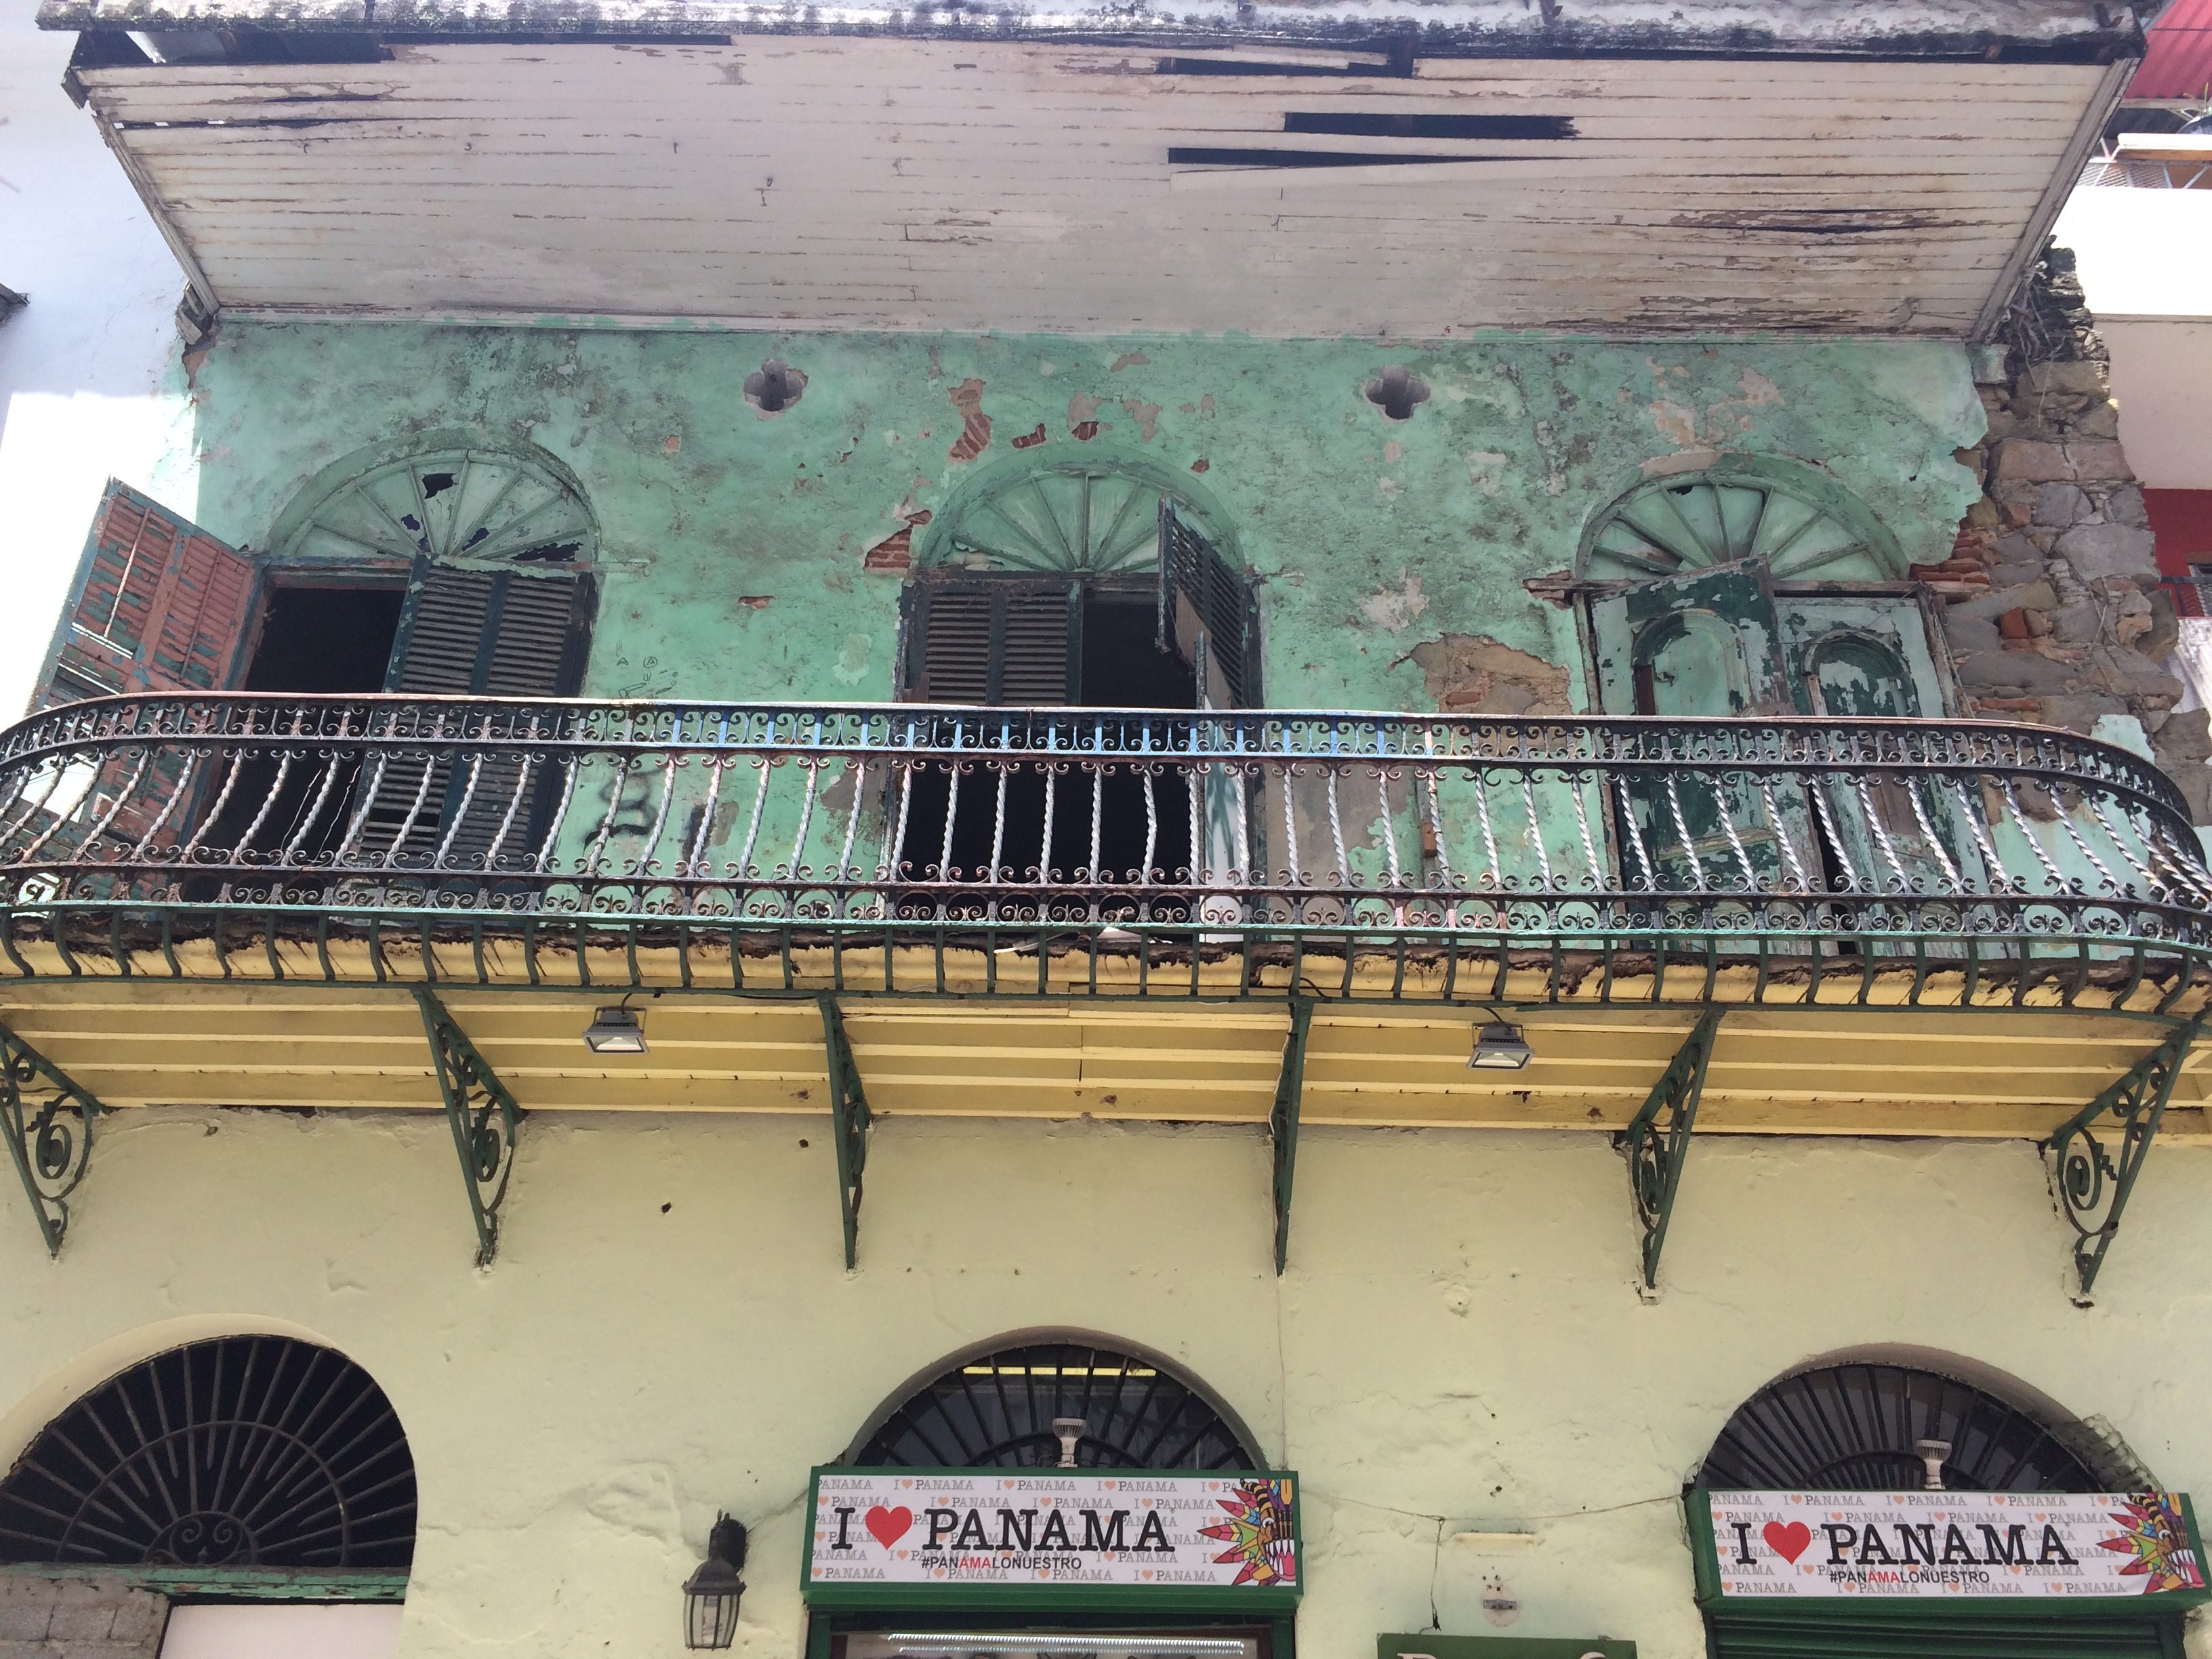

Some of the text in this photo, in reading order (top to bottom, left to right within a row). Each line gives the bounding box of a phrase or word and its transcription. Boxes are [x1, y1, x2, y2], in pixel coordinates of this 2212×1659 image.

[915, 1479, 974, 1490] PANAMA
[1017, 1480, 1076, 1491] PANAMA
[1118, 1481, 1178, 1492] PANAMA
[831, 1496, 890, 1507] PANAMA
[951, 1497, 1010, 1509] PANAMA
[1054, 1498, 1113, 1509] PANAMA
[1155, 1498, 1214, 1510] PANAMA
[1805, 1495, 1864, 1506] PANAMA
[1908, 1496, 1967, 1506] PANAMA
[2008, 1496, 2067, 1507] PANAMA
[1725, 1512, 1785, 1523] PANAMA
[1845, 1512, 1906, 1523] PANAMA
[1948, 1513, 2009, 1523] PANAMA
[2049, 1513, 2109, 1523] PANAMA
[832, 1506, 1176, 1552] I PANAMA
[1730, 1522, 2079, 1565] I PANAMA
[922, 1556, 1082, 1570] #PANAMALONUESTRO
[1118, 1552, 1178, 1563] PANAMA
[825, 1568, 885, 1578] PANAMA
[949, 1568, 1008, 1580] PANAMA
[1053, 1569, 1113, 1580] PANAMA
[1156, 1570, 1216, 1581] PANAMA
[2024, 1565, 2085, 1576] PANAMA
[1829, 1572, 1990, 1584] #PANAMALONUESTRO
[1736, 1582, 1797, 1594] PANAMA
[1859, 1583, 1920, 1594] PANAMA
[1963, 1583, 2024, 1594] PANAMA
[2066, 1583, 2127, 1594] PANAMA
